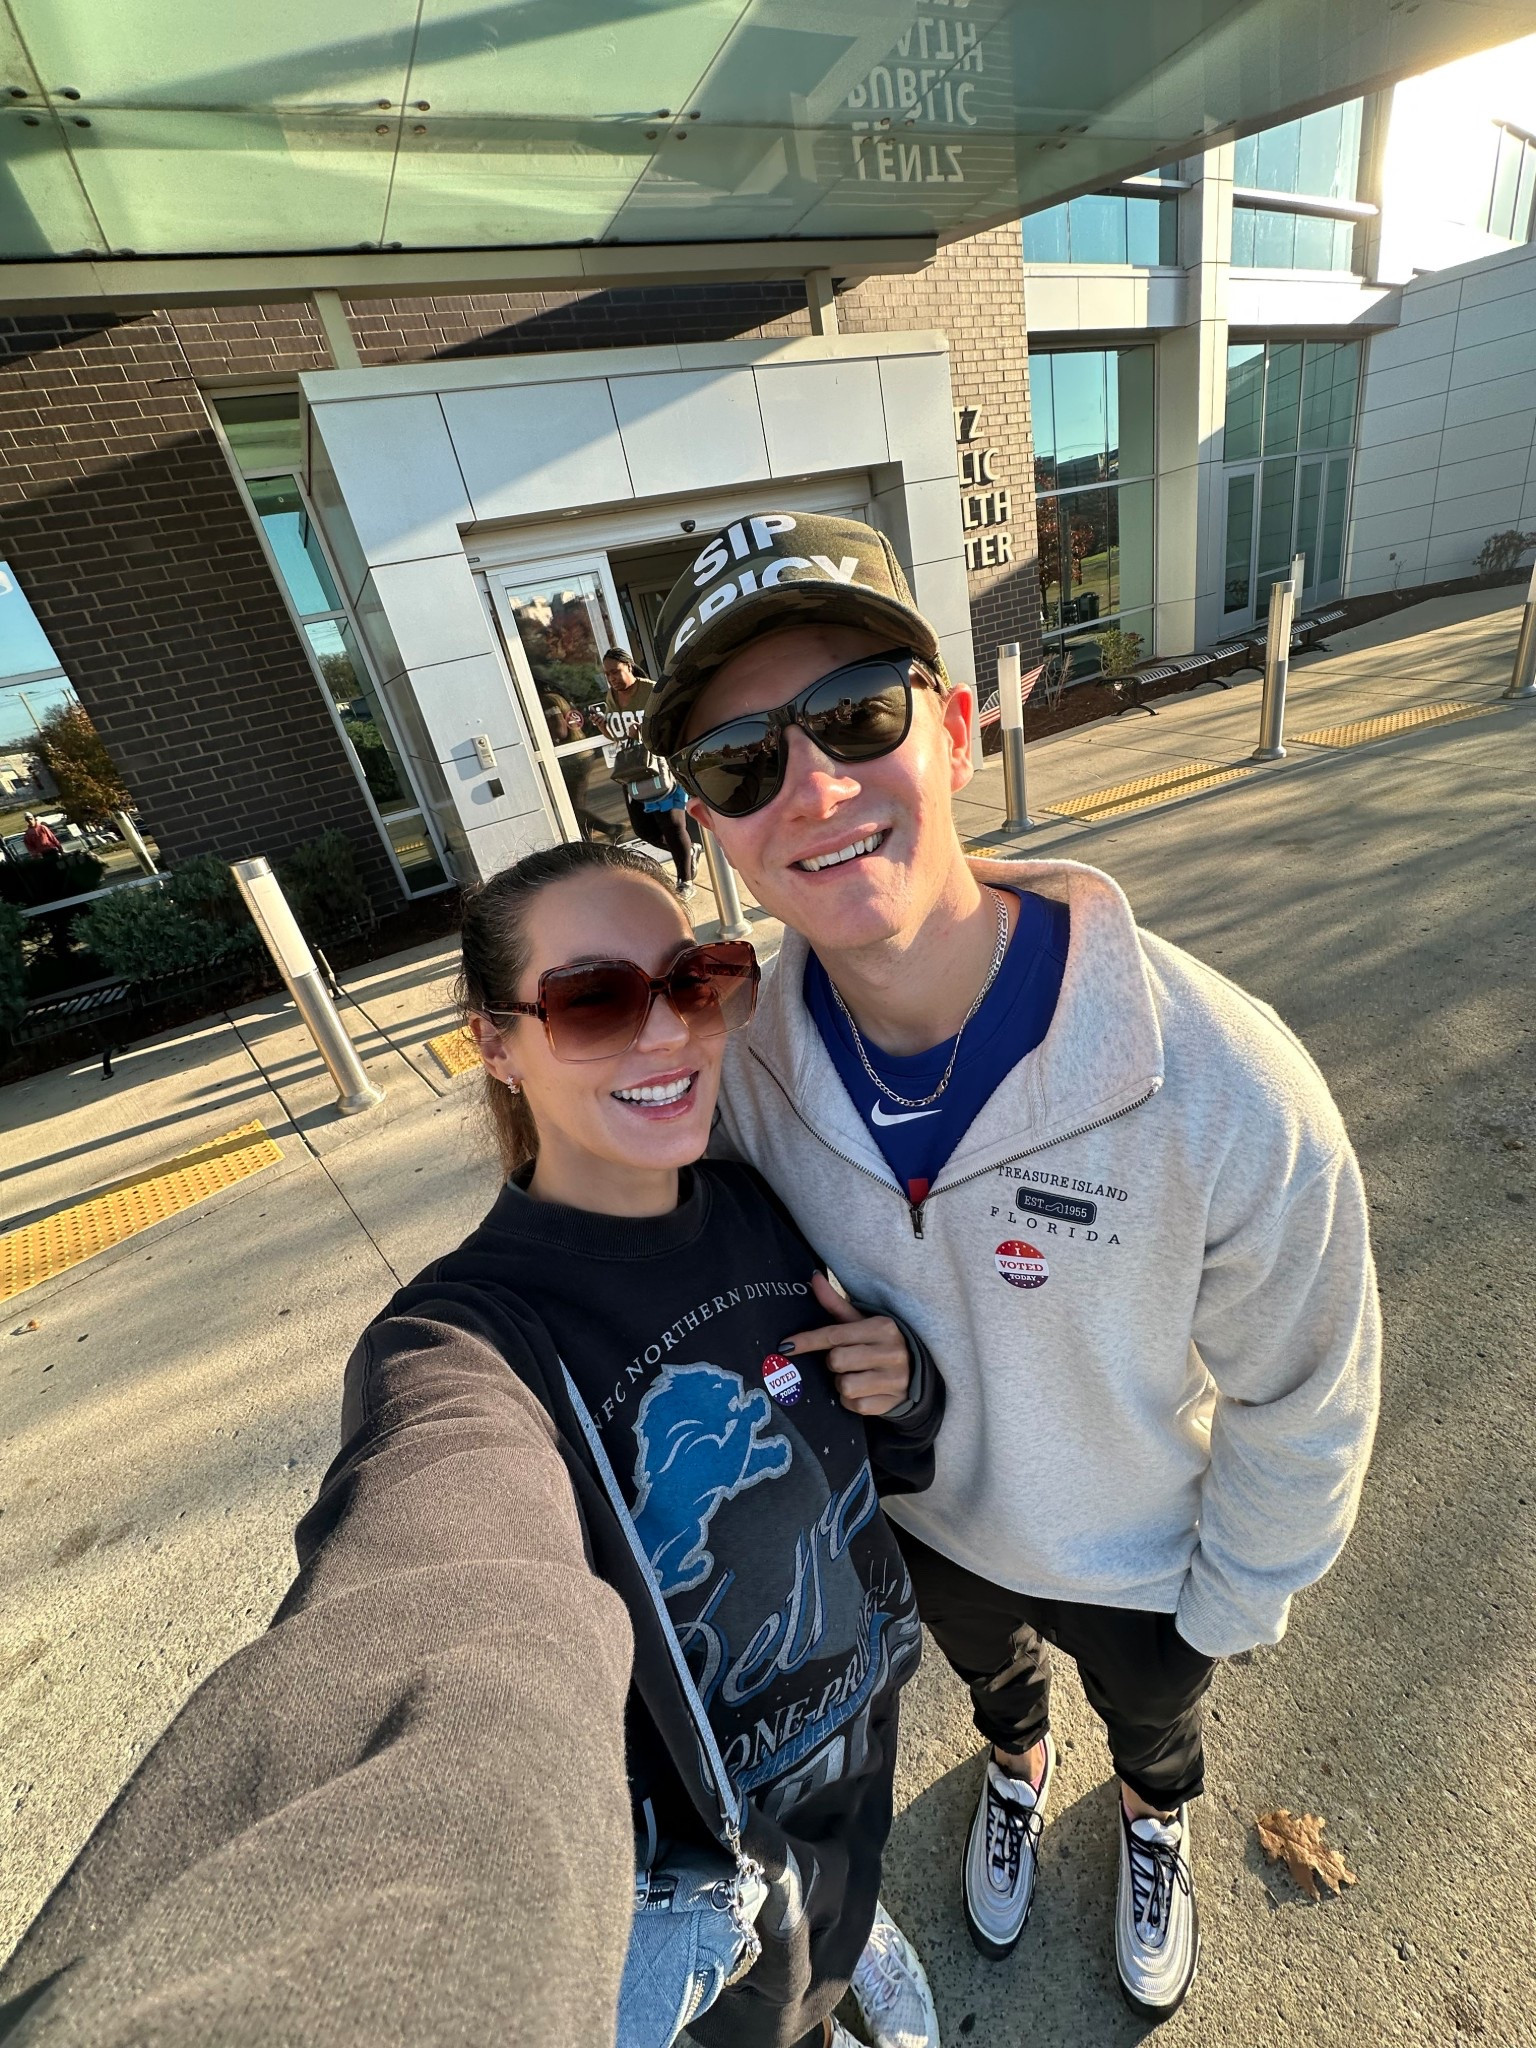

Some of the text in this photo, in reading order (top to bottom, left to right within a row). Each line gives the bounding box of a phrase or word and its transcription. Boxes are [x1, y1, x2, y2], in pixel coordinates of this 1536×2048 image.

[957, 447, 1001, 485] LIC
[962, 490, 1012, 529] LTH
[693, 514, 797, 587] SIP
[964, 531, 1015, 569] TER
[998, 1165, 1128, 1202] TREASURE ISLAND
[1064, 1204, 1088, 1218] 1955
[999, 1260, 1044, 1272] VOTED
[1009, 1273, 1036, 1281] TODAY
[625, 1288, 741, 1384] NORTHERN
[769, 1370, 797, 1389] VOTED
[780, 1385, 798, 1399] TODAY
